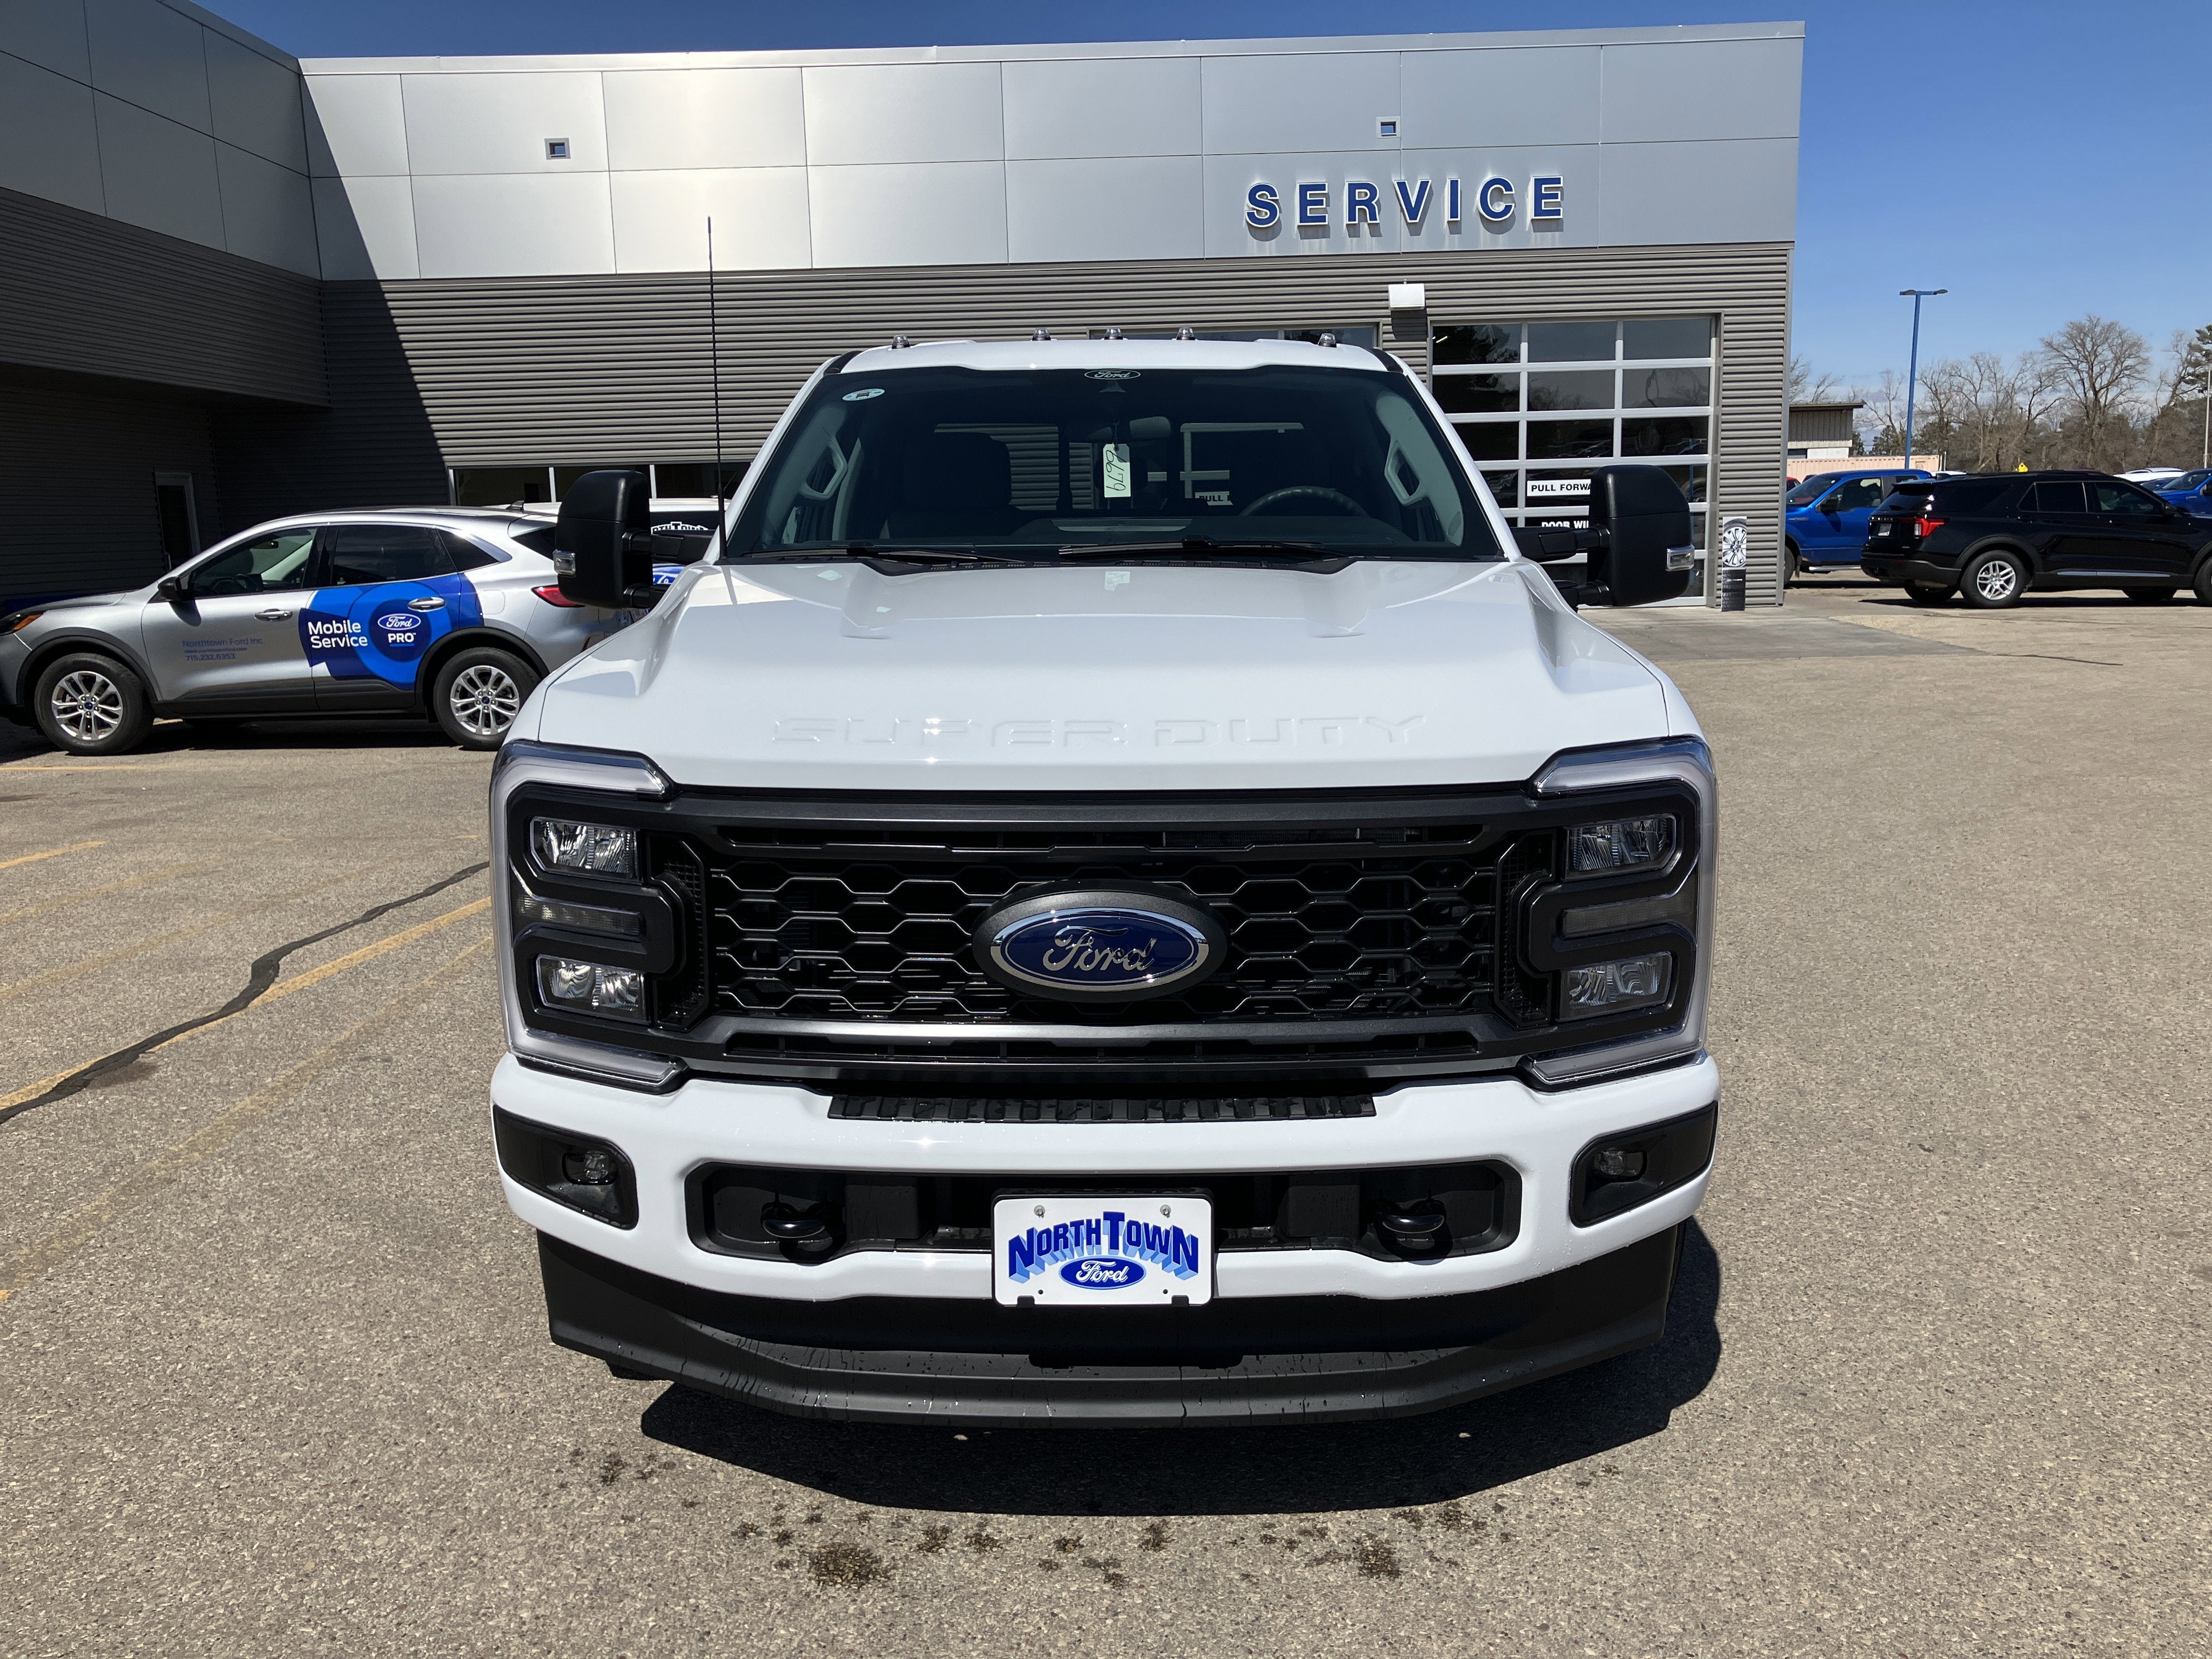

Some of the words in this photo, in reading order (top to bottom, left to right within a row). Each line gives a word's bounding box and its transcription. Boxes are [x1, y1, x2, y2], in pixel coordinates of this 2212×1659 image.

[1244, 176, 1564, 228] SERVICE
[308, 619, 362, 635] Mobile
[386, 616, 413, 628] Ford
[182, 639, 228, 648] Northtown
[229, 637, 249, 646] Ford
[310, 634, 368, 649] Service
[772, 718, 1128, 747] SUPER
[1154, 715, 1427, 747] DUTY
[1042, 926, 1158, 971] Ford
[1075, 1260, 1130, 1283] Ford
